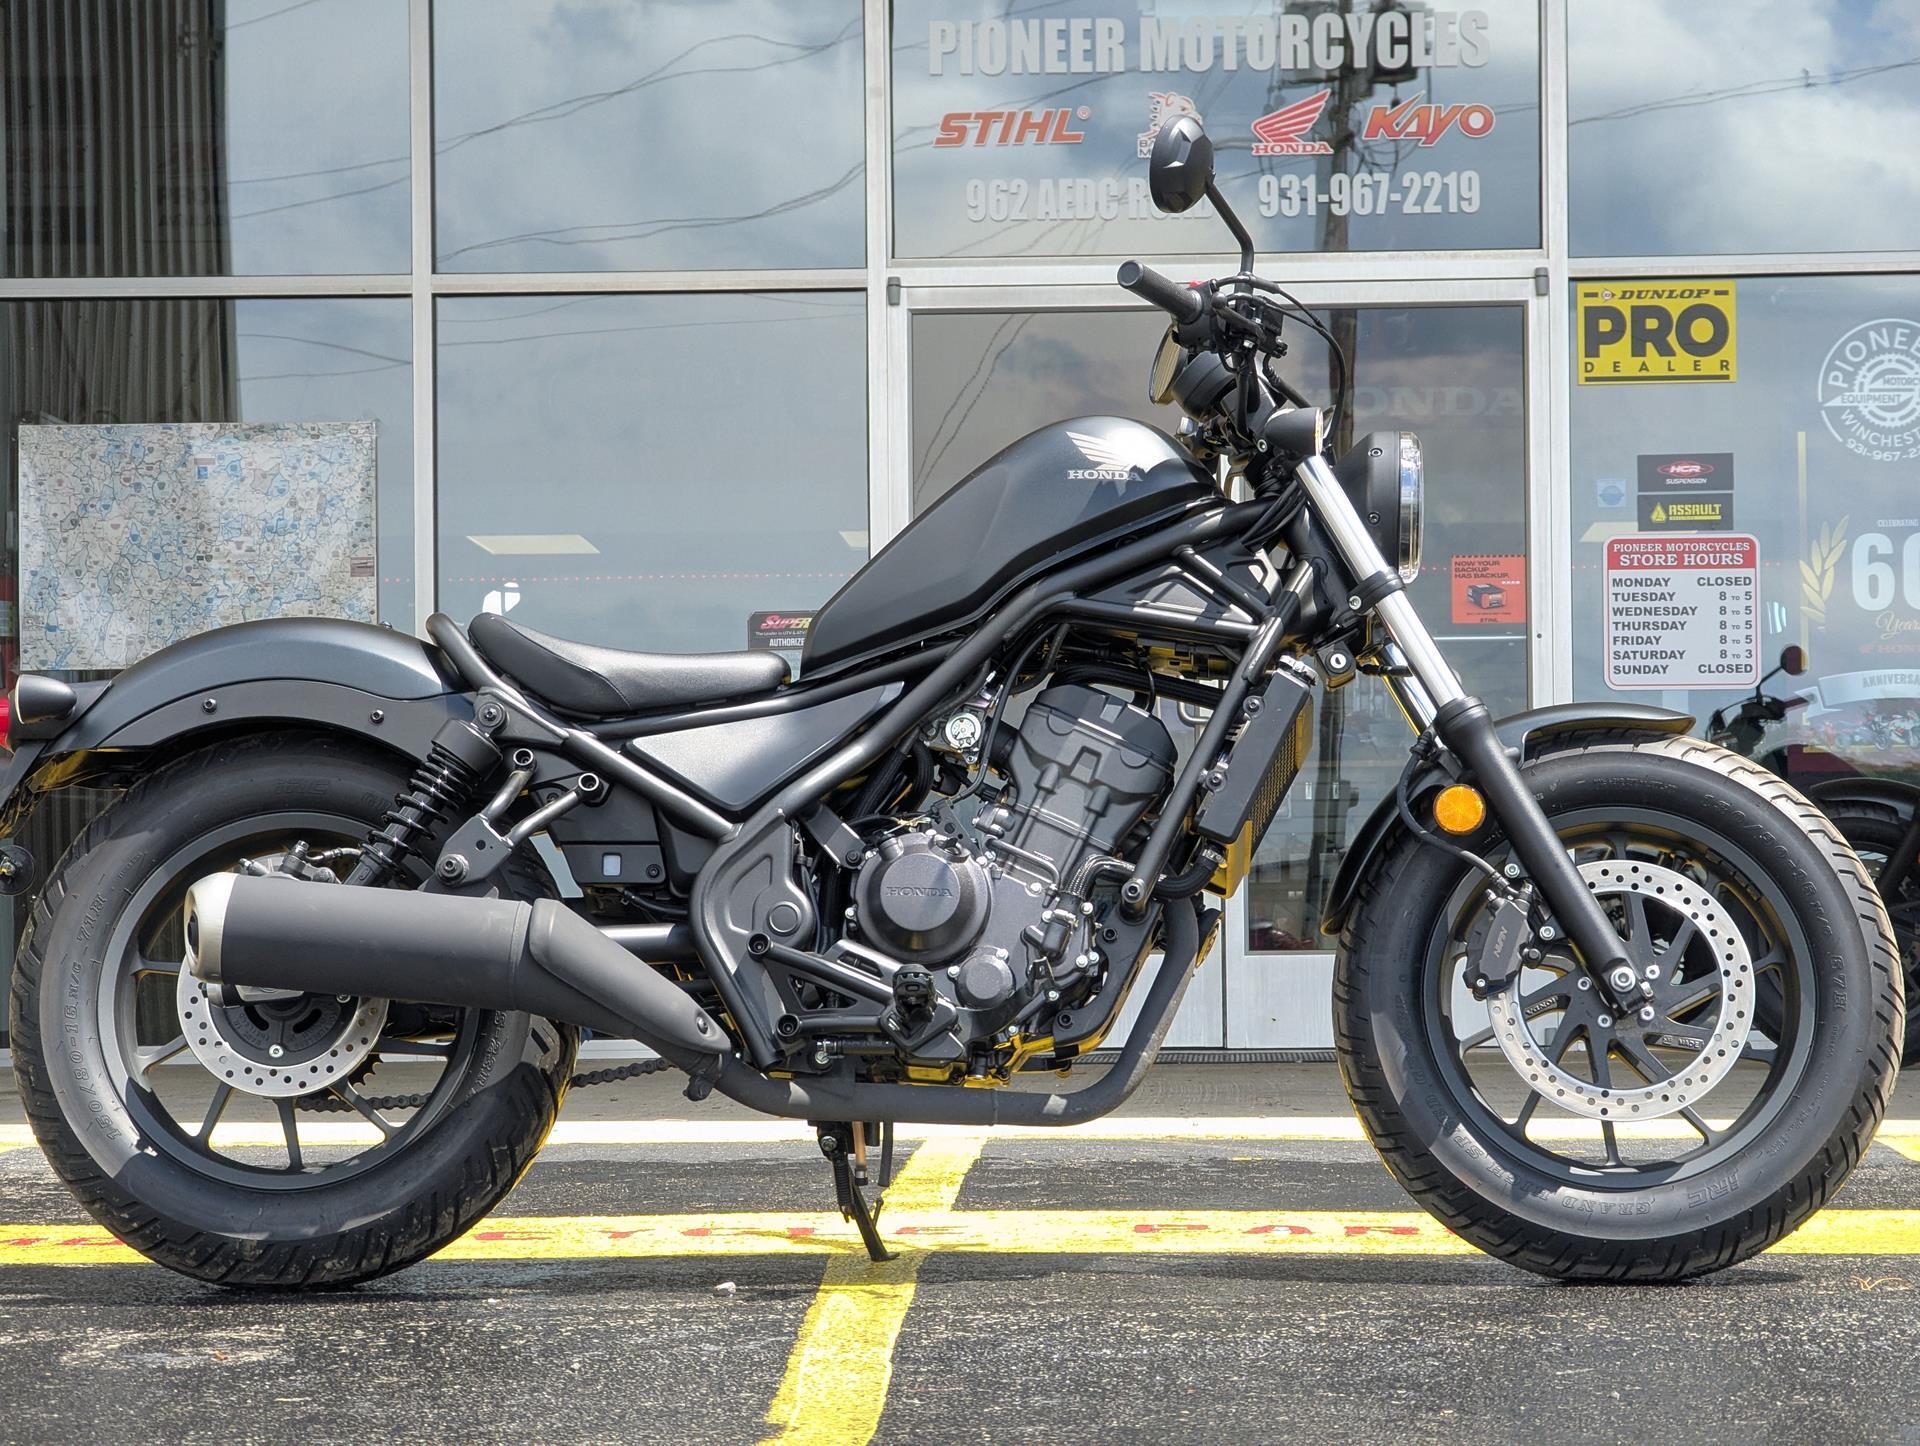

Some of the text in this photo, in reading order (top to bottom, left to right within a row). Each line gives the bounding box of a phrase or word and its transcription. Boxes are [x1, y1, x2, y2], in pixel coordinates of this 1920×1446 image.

[928, 9, 1492, 75] PIONEER MOTORCYCLES
[1363, 89, 1495, 147] KAYO
[1252, 142, 1334, 155] HONDA
[966, 178, 1029, 222] 962
[1036, 176, 1119, 221] AEDC
[1258, 170, 1481, 218] 931-967-2219
[1619, 289, 1711, 300] DUNLOP
[1584, 303, 1730, 358] PRO
[1584, 360, 1730, 373] DEALER
[1841, 394, 1901, 404] EQUIPMENT
[1670, 465, 1702, 473] HCR
[1067, 469, 1143, 481] HONDA
[1668, 503, 1721, 515] ASSAULT
[1613, 542, 1750, 552] PIONEER MOTORCYCLES
[1620, 553, 1743, 566] STORE HOURS
[1612, 576, 1752, 587] MONDAY CLOSED
[1612, 592, 1676, 602] TUESDAY
[1719, 591, 1727, 600] 8
[1744, 591, 1752, 600] 5
[1612, 606, 1698, 616] WEDNESDAY
[1719, 606, 1727, 615] 8
[1744, 606, 1752, 615] 5
[1612, 621, 1687, 631] THURSDAY
[1719, 620, 1727, 629] 8
[1744, 620, 1752, 629] 5
[1612, 635, 1662, 645] FRIDAY
[1719, 635, 1727, 644] 8
[1744, 635, 1752, 644] 5
[1612, 650, 1686, 660] SATURDAY
[1719, 649, 1727, 659] 8
[1744, 649, 1752, 659] 3
[1613, 664, 1753, 674] SUNDAY CLOSED
[886, 886, 953, 897] HONDA
[1562, 1196, 1650, 1216] GRAND
[1135, 1223, 1420, 1236] PAR
